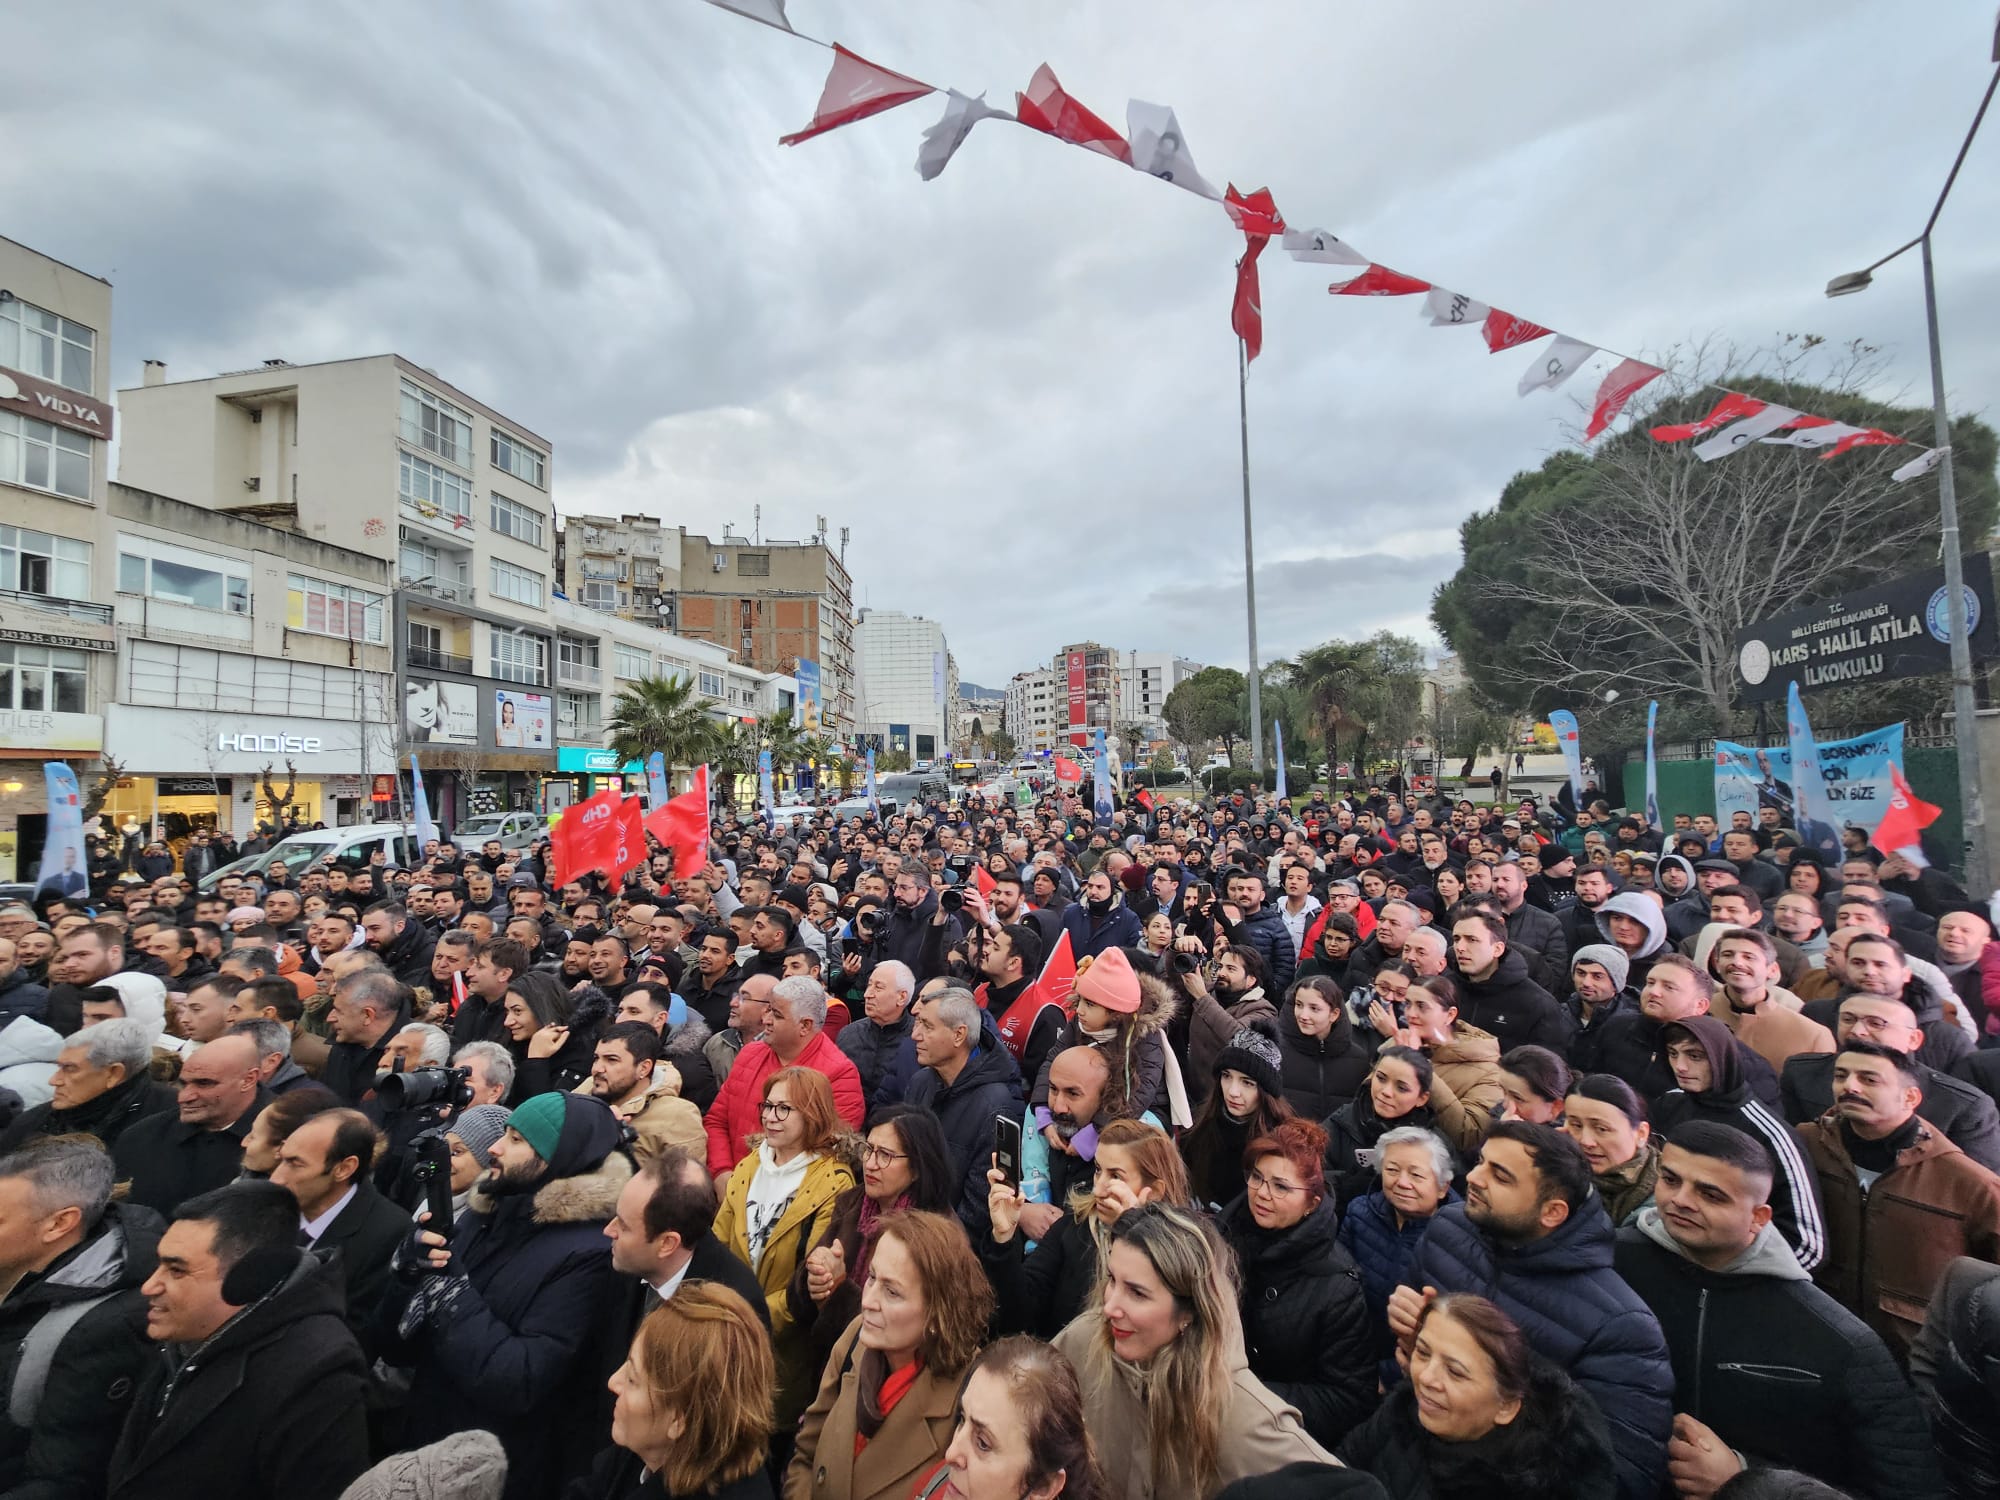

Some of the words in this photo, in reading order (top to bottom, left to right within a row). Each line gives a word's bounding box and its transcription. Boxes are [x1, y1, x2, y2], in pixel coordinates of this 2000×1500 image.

[34, 391, 101, 425] VİDYA
[1791, 623, 1812, 639] MİLLİ
[1812, 616, 1840, 634] EĞİTİM
[1841, 602, 1889, 626] BAKANLIĞI
[1828, 602, 1845, 614] T.C.
[1771, 643, 1809, 668] KARS
[1819, 622, 1867, 657] HALİL
[1869, 614, 1923, 647] ATİLA
[1804, 653, 1884, 686] İLKOKULU
[1850, 783, 1876, 800] BİZE
